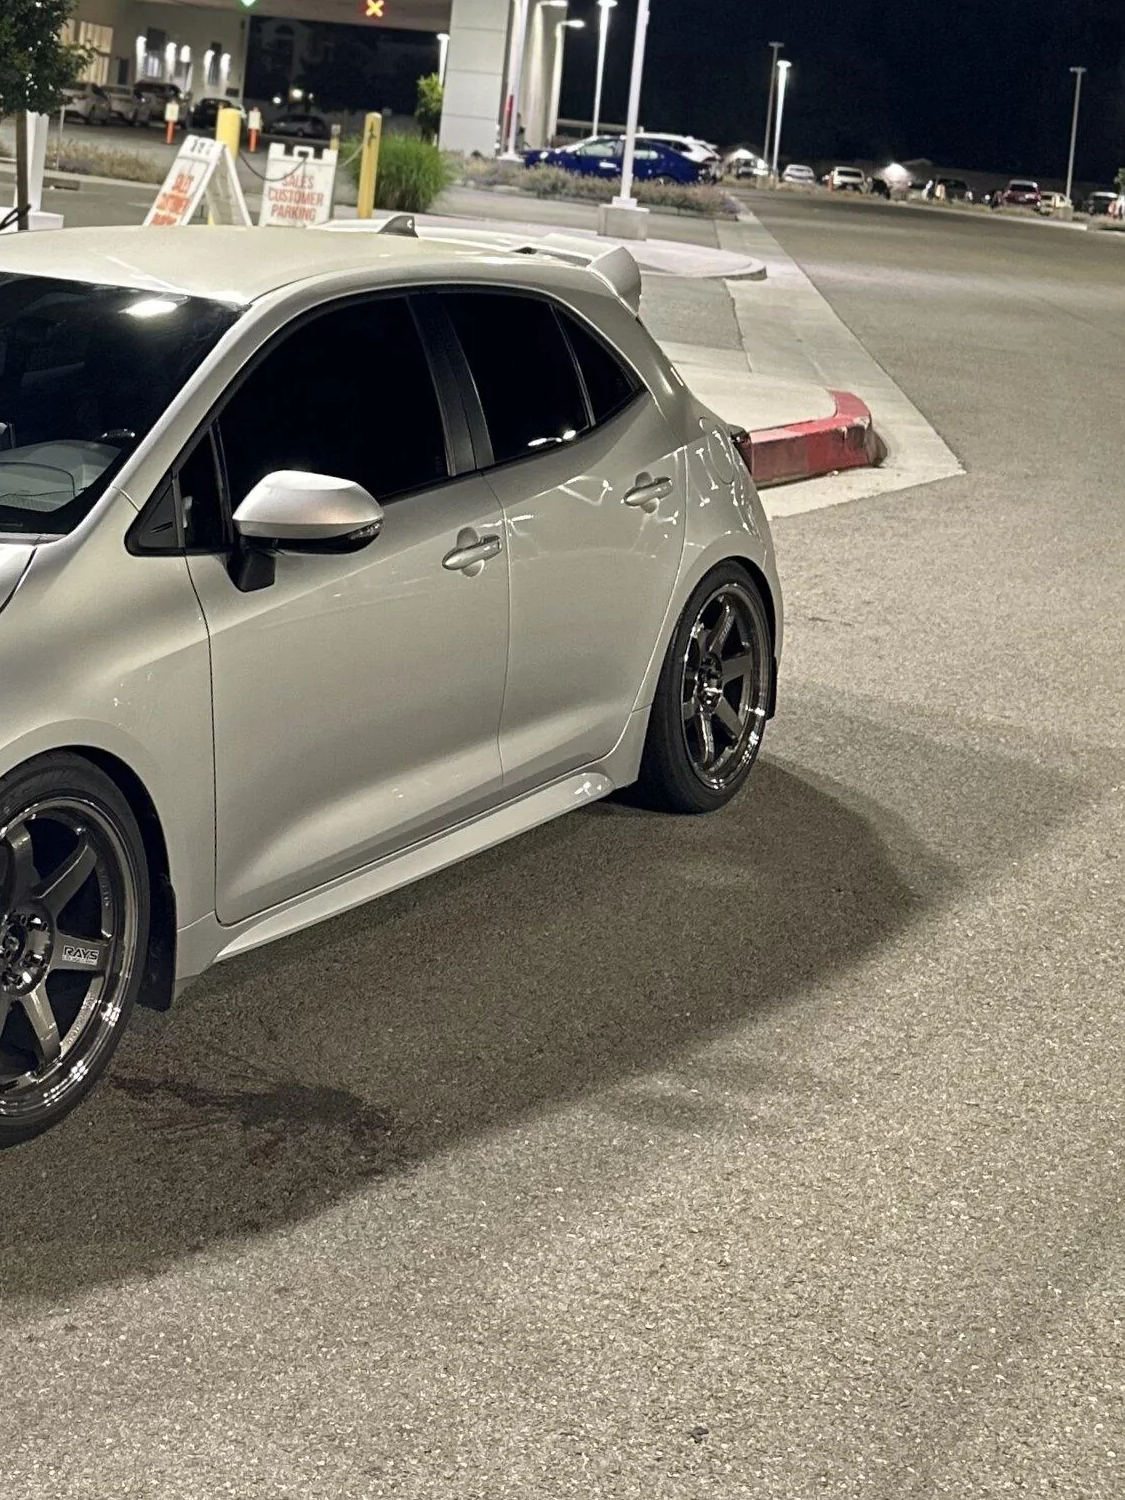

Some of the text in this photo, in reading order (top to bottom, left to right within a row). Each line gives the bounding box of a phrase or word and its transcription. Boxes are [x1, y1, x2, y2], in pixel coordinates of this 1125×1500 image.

[282, 172, 315, 190] SALES
[268, 186, 325, 207] CUSTOMER
[271, 203, 317, 221] PARKING
[63, 945, 99, 961] RAYS
